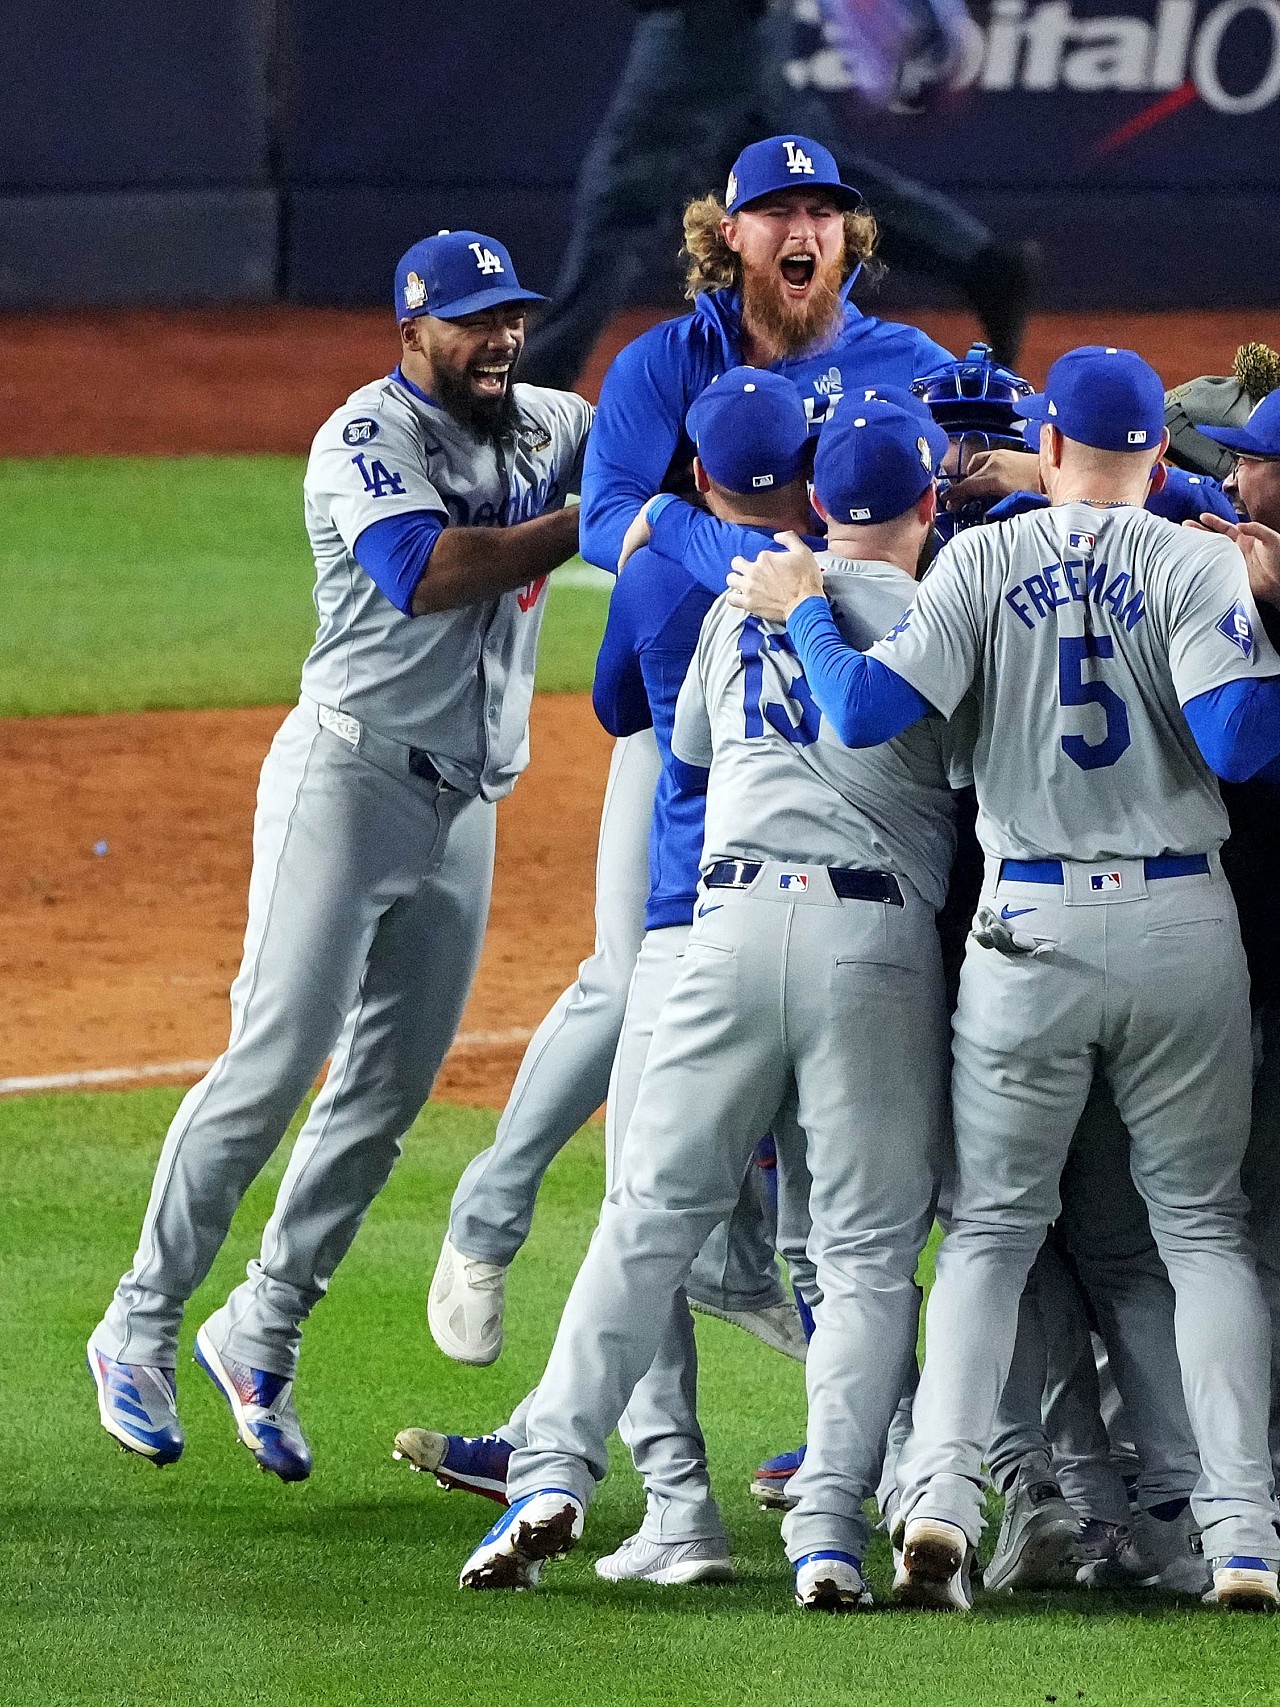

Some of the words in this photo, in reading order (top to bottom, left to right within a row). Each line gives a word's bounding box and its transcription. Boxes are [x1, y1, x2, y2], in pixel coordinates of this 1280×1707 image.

[783, 142, 815, 174] LA
[468, 242, 505, 275] LA
[348, 426, 371, 443] 34
[351, 452, 407, 498] LA
[1004, 560, 1146, 633] FREEMAN
[737, 614, 823, 749] 13
[1058, 634, 1132, 772] 5
